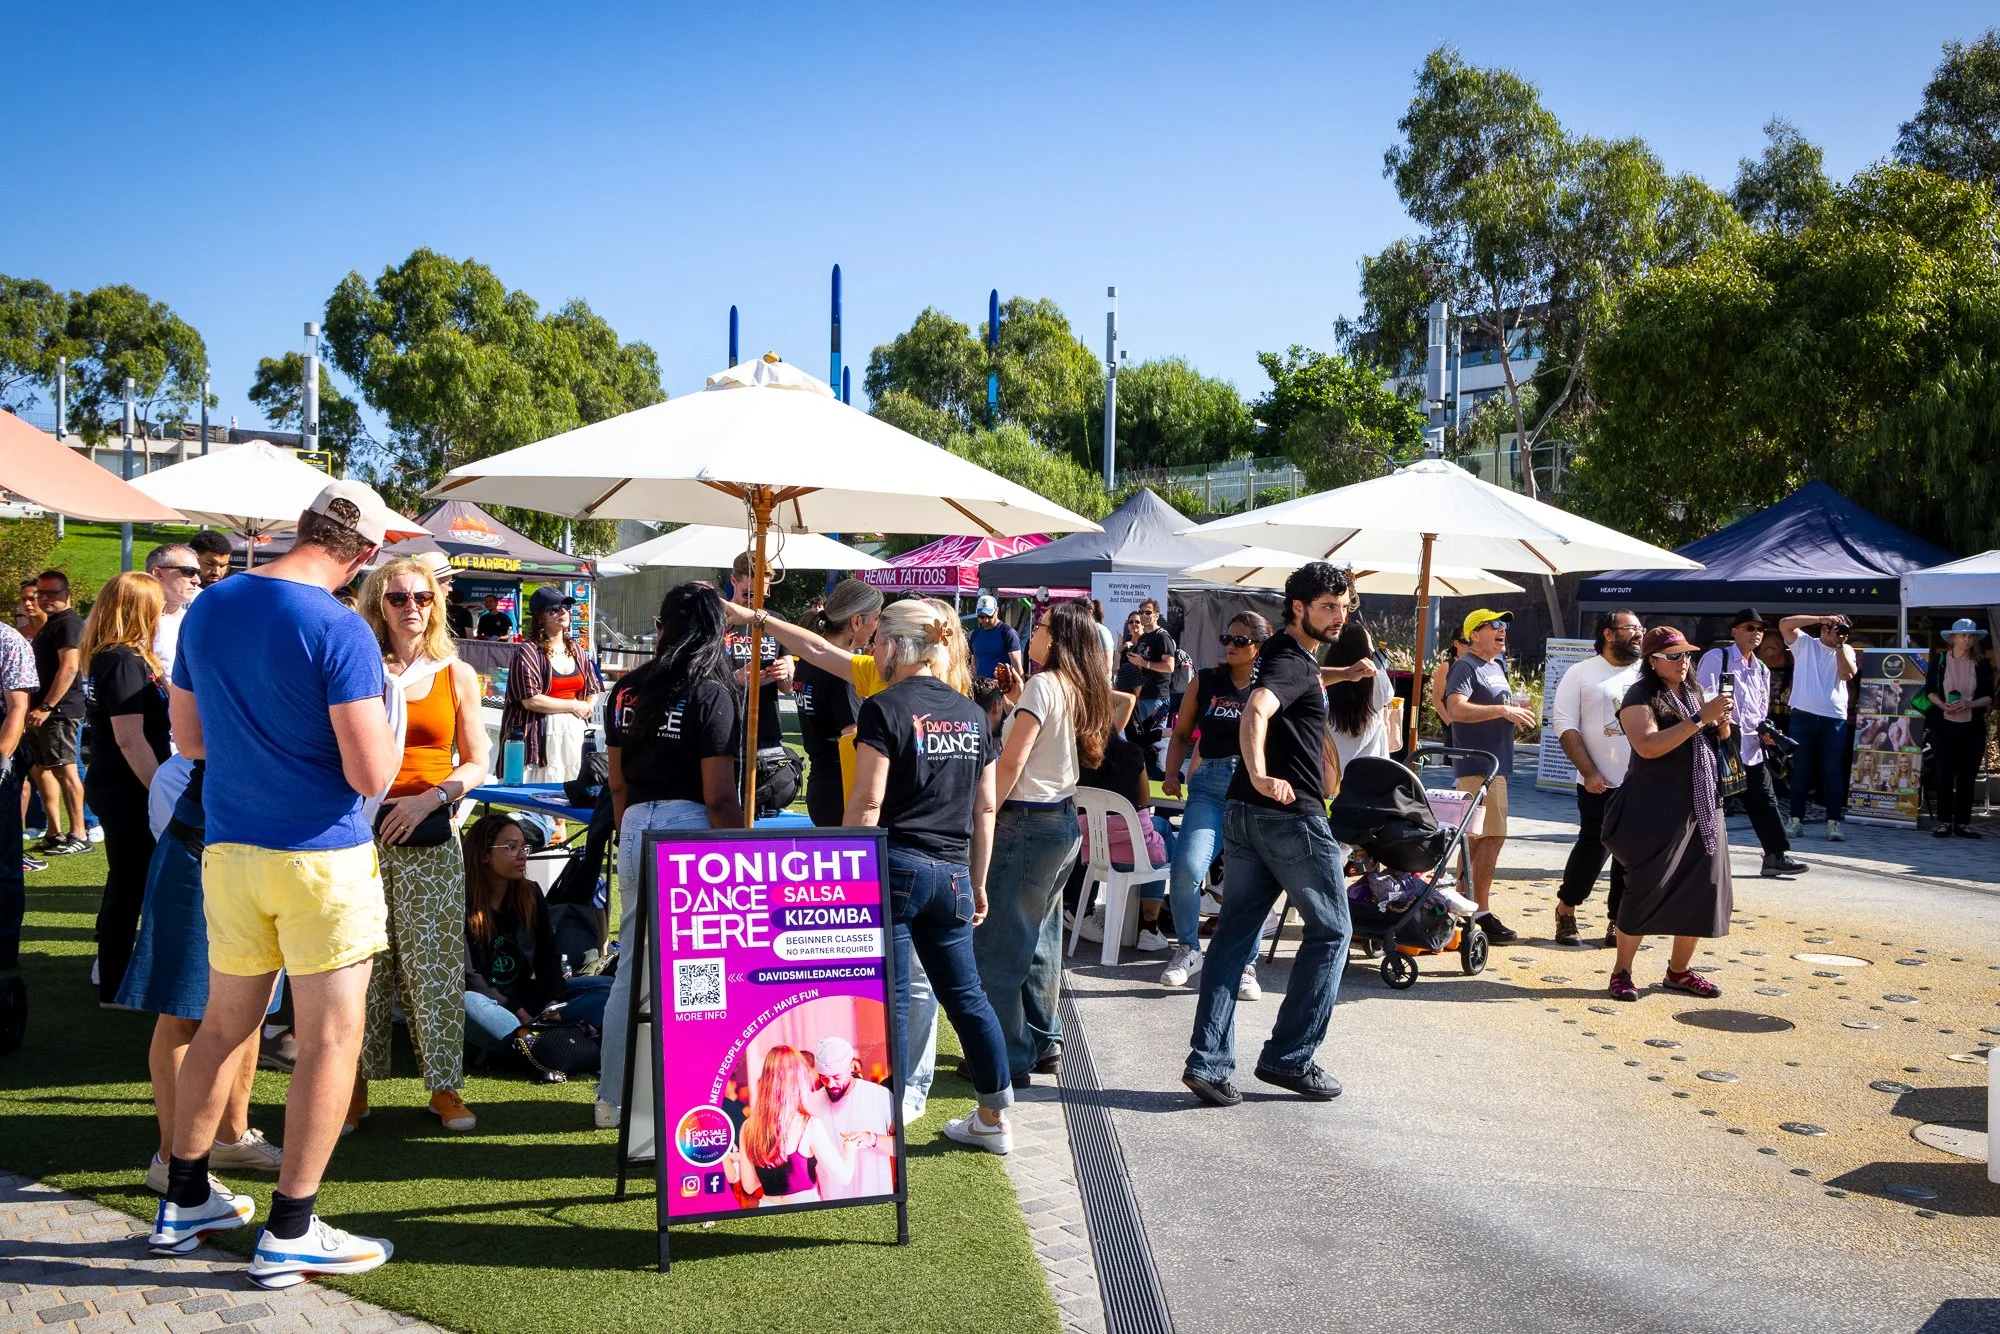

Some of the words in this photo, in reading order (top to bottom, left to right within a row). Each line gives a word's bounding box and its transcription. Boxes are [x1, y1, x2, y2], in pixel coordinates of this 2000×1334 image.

[473, 556, 521, 572] BARBECUE
[864, 569, 896, 584] HENNA
[900, 568, 946, 584] TATTOOS
[926, 720, 952, 732] DAVID
[927, 733, 980, 753] DANCE
[669, 851, 866, 884] TONIGHT
[670, 884, 768, 913] DANCE
[784, 885, 846, 902] SALSA
[785, 908, 872, 926] KIZOMBA
[671, 912, 770, 951] HERE
[786, 936, 832, 944] BEGINNER
[835, 934, 874, 942] CLASSES
[758, 967, 875, 982] DAVIDSMILEDANCE.COM
[676, 1012, 702, 1021] MORE
[705, 1011, 727, 1020] INFO
[709, 1077, 724, 1104] MEET
[720, 1038, 745, 1075] PEOPLE.
[742, 1022, 759, 1038] GET
[759, 1009, 774, 1025] FIT.
[773, 994, 799, 1013] HAVE
[799, 988, 819, 1001] FUN
[692, 1135, 727, 1147] DANCE
